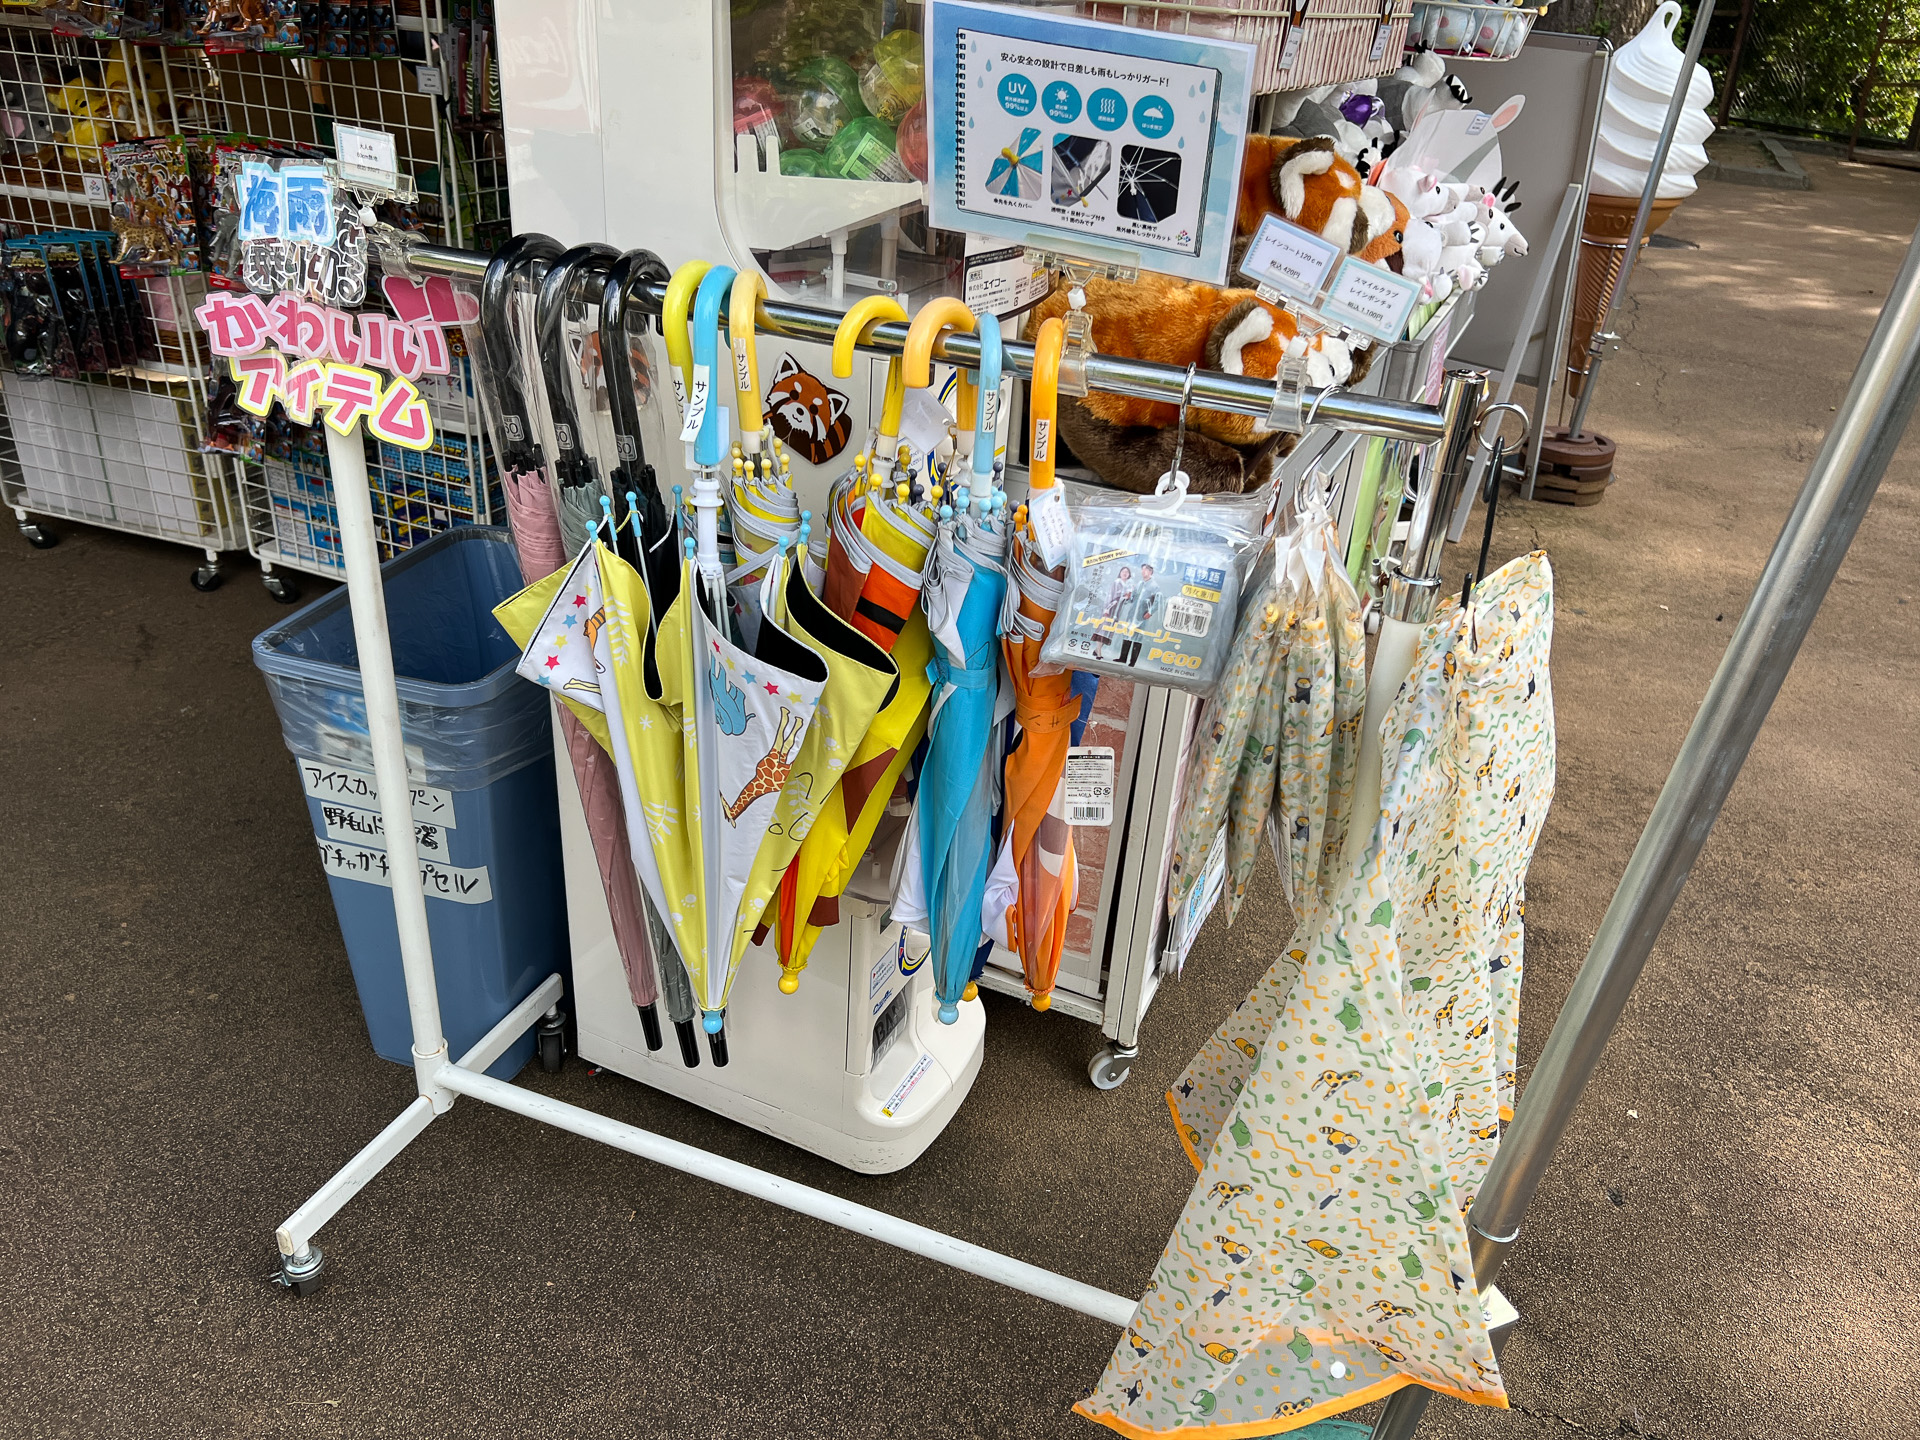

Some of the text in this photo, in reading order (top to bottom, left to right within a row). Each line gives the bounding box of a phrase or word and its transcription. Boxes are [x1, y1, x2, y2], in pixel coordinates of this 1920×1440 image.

[1000, 52, 1170, 88] 安心安全の設計で日差しも雨もしっかりガード!
[1008, 81, 1027, 95] UV
[1115, 225, 1172, 242] 紫外線をしっかりカット
[248, 240, 368, 306] 乗り切る
[1270, 259, 1301, 279] 税込 420円
[1349, 287, 1392, 310] レインポンチョ
[1354, 276, 1400, 298] スマイルクラブ
[1347, 301, 1360, 311] 税込
[204, 298, 444, 376] かわいい
[736, 353, 749, 390] サンプル
[238, 357, 426, 441] アイテム
[688, 380, 707, 430] サンプル
[984, 390, 996, 430] サンプル
[1035, 421, 1049, 460] サンプル
[1185, 566, 1221, 583] 雨物語
[1074, 611, 1182, 644] レインストーリー
[1147, 647, 1203, 670] P600
[1180, 669, 1195, 677] CHINA
